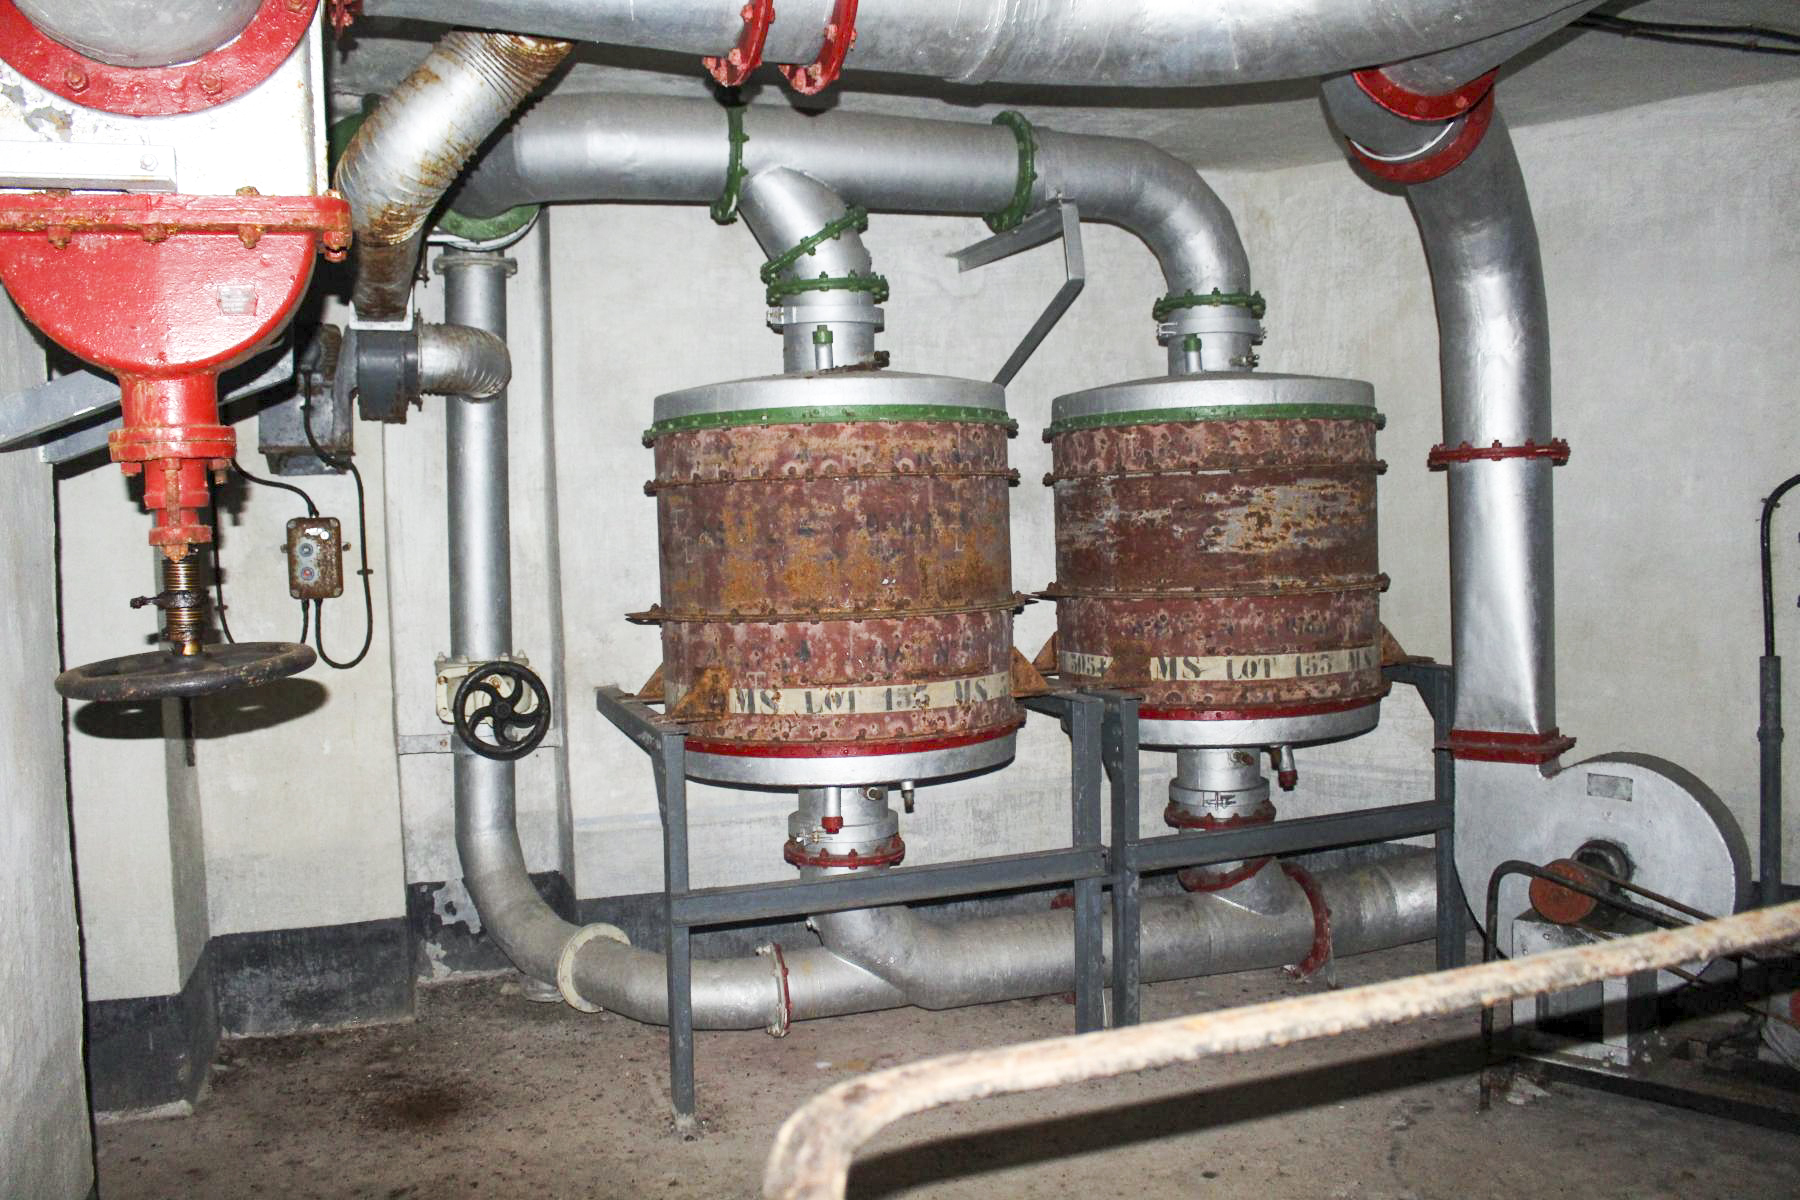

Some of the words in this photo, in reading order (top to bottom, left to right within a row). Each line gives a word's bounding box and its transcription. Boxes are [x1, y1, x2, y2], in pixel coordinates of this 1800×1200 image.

[1156, 656, 1201, 680] MS
[1226, 656, 1277, 680] LOT
[735, 687, 780, 713] MS
[804, 689, 861, 713] LOT
